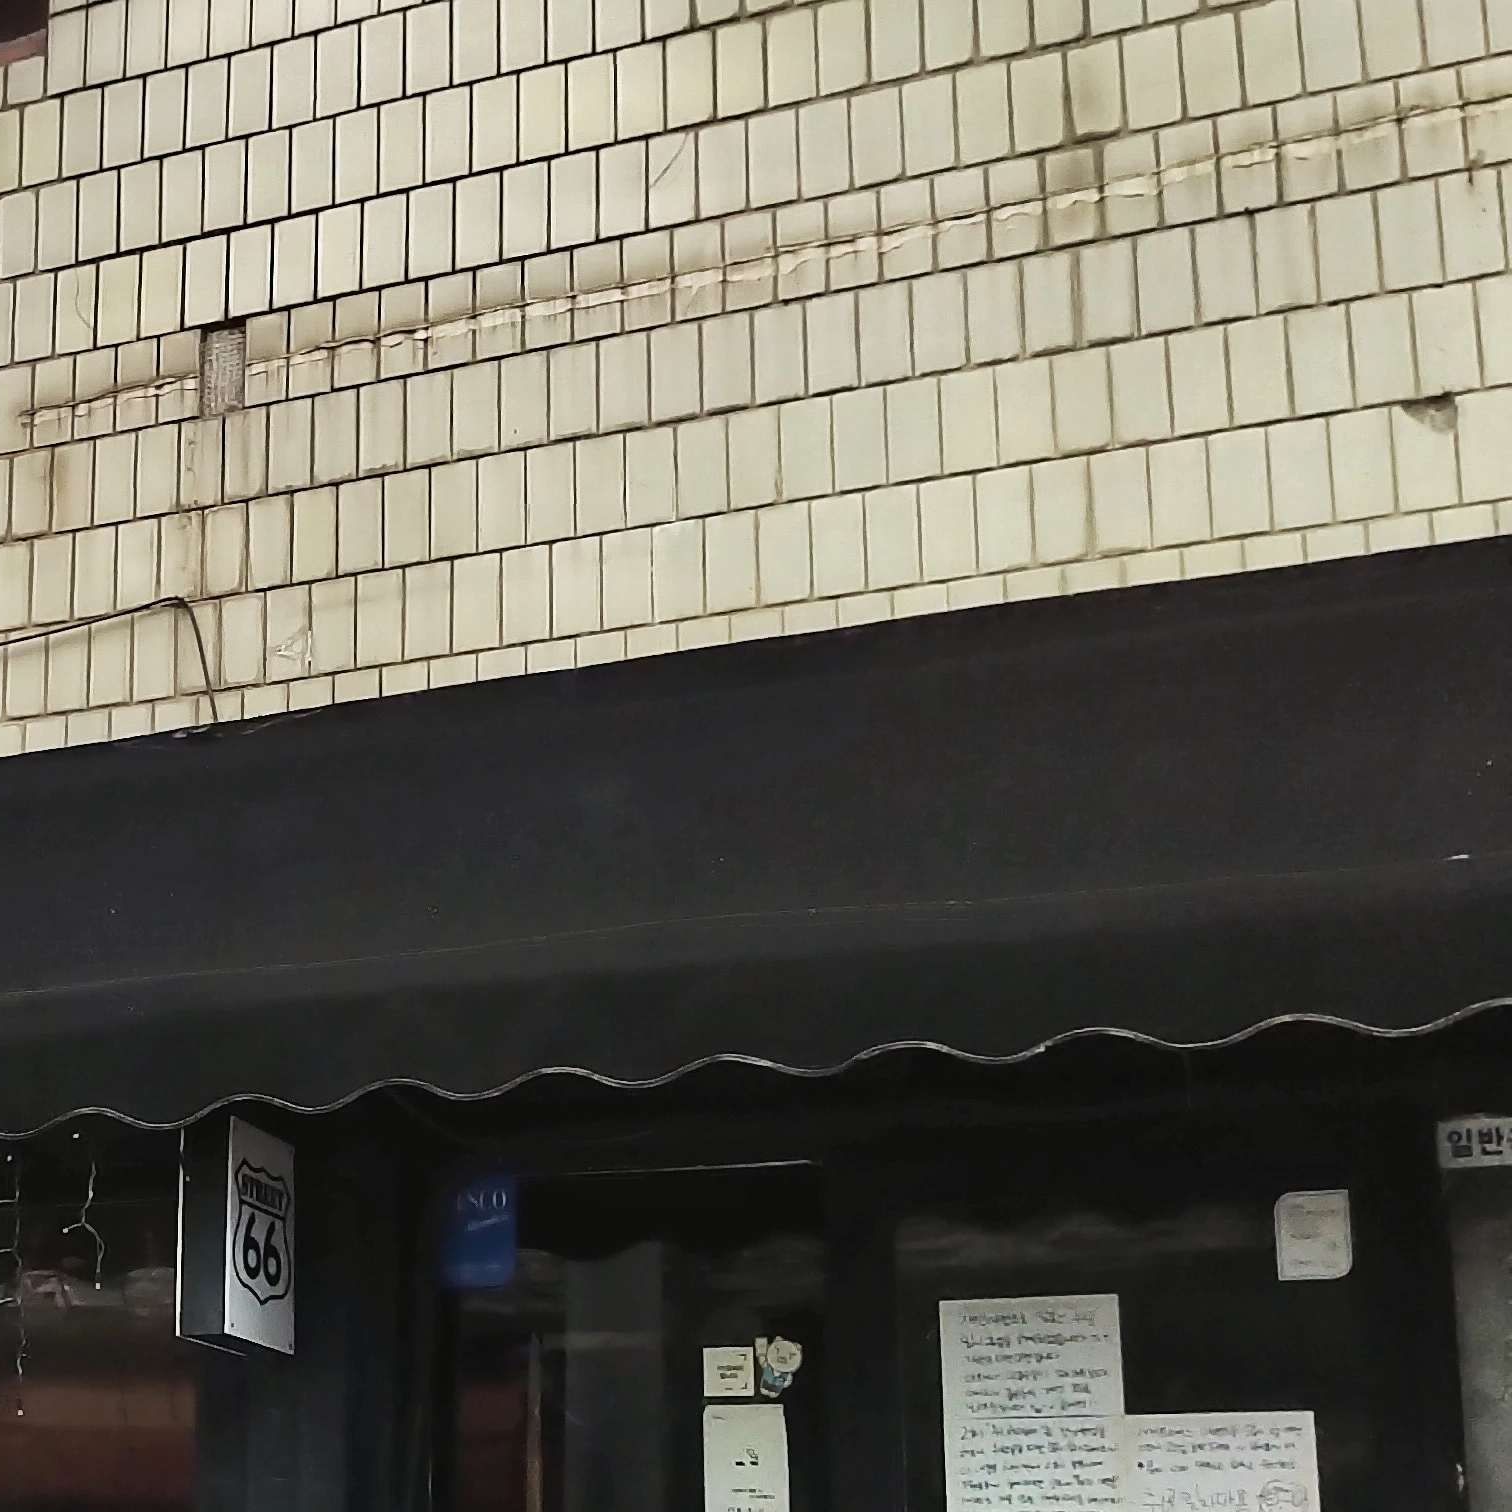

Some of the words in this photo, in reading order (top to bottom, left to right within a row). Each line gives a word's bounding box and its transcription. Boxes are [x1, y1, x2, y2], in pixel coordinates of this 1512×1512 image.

[1447, 1127, 1512, 1158] 일반
[241, 1173, 285, 1212] STREET
[243, 1211, 282, 1287] 66
